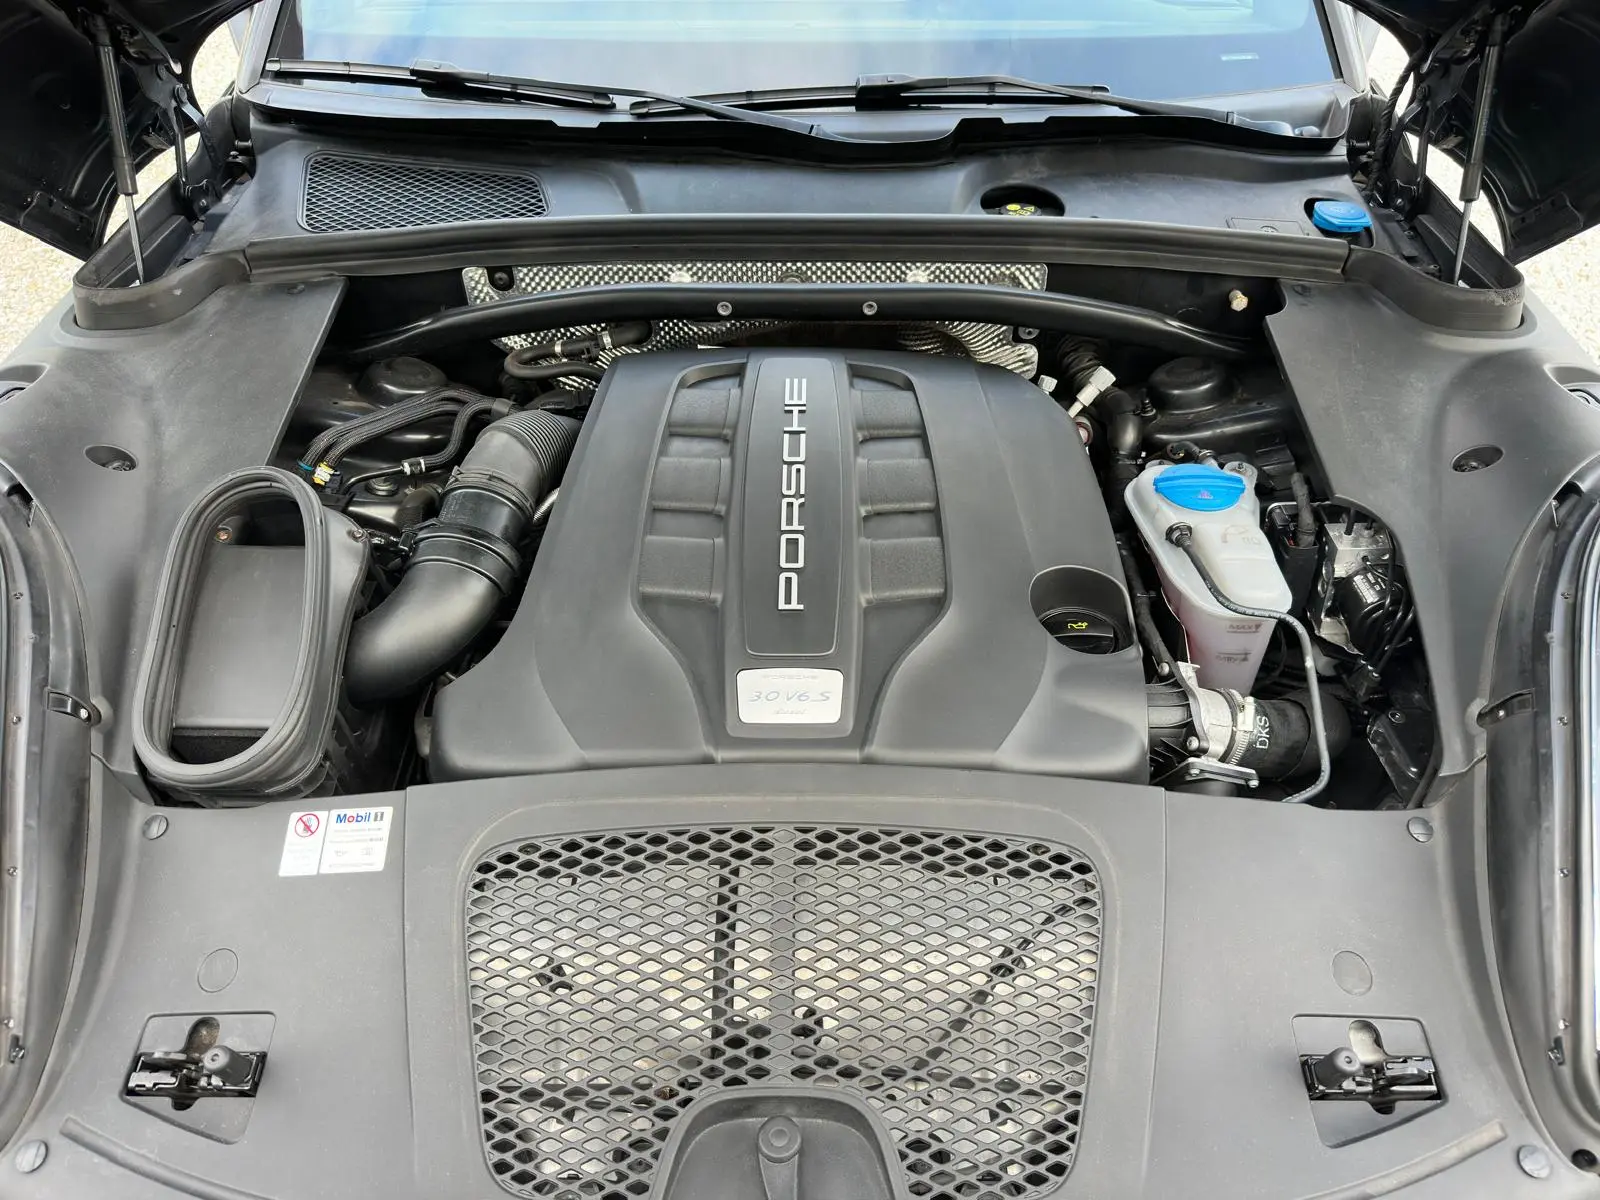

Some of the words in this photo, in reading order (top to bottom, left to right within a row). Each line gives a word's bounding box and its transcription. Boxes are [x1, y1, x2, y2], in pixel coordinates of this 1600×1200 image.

[778, 377, 807, 611] PORSCHE
[786, 691, 810, 703] V6
[811, 691, 832, 703] S
[1256, 715, 1270, 750] DKS
[335, 812, 371, 824] Mobil
